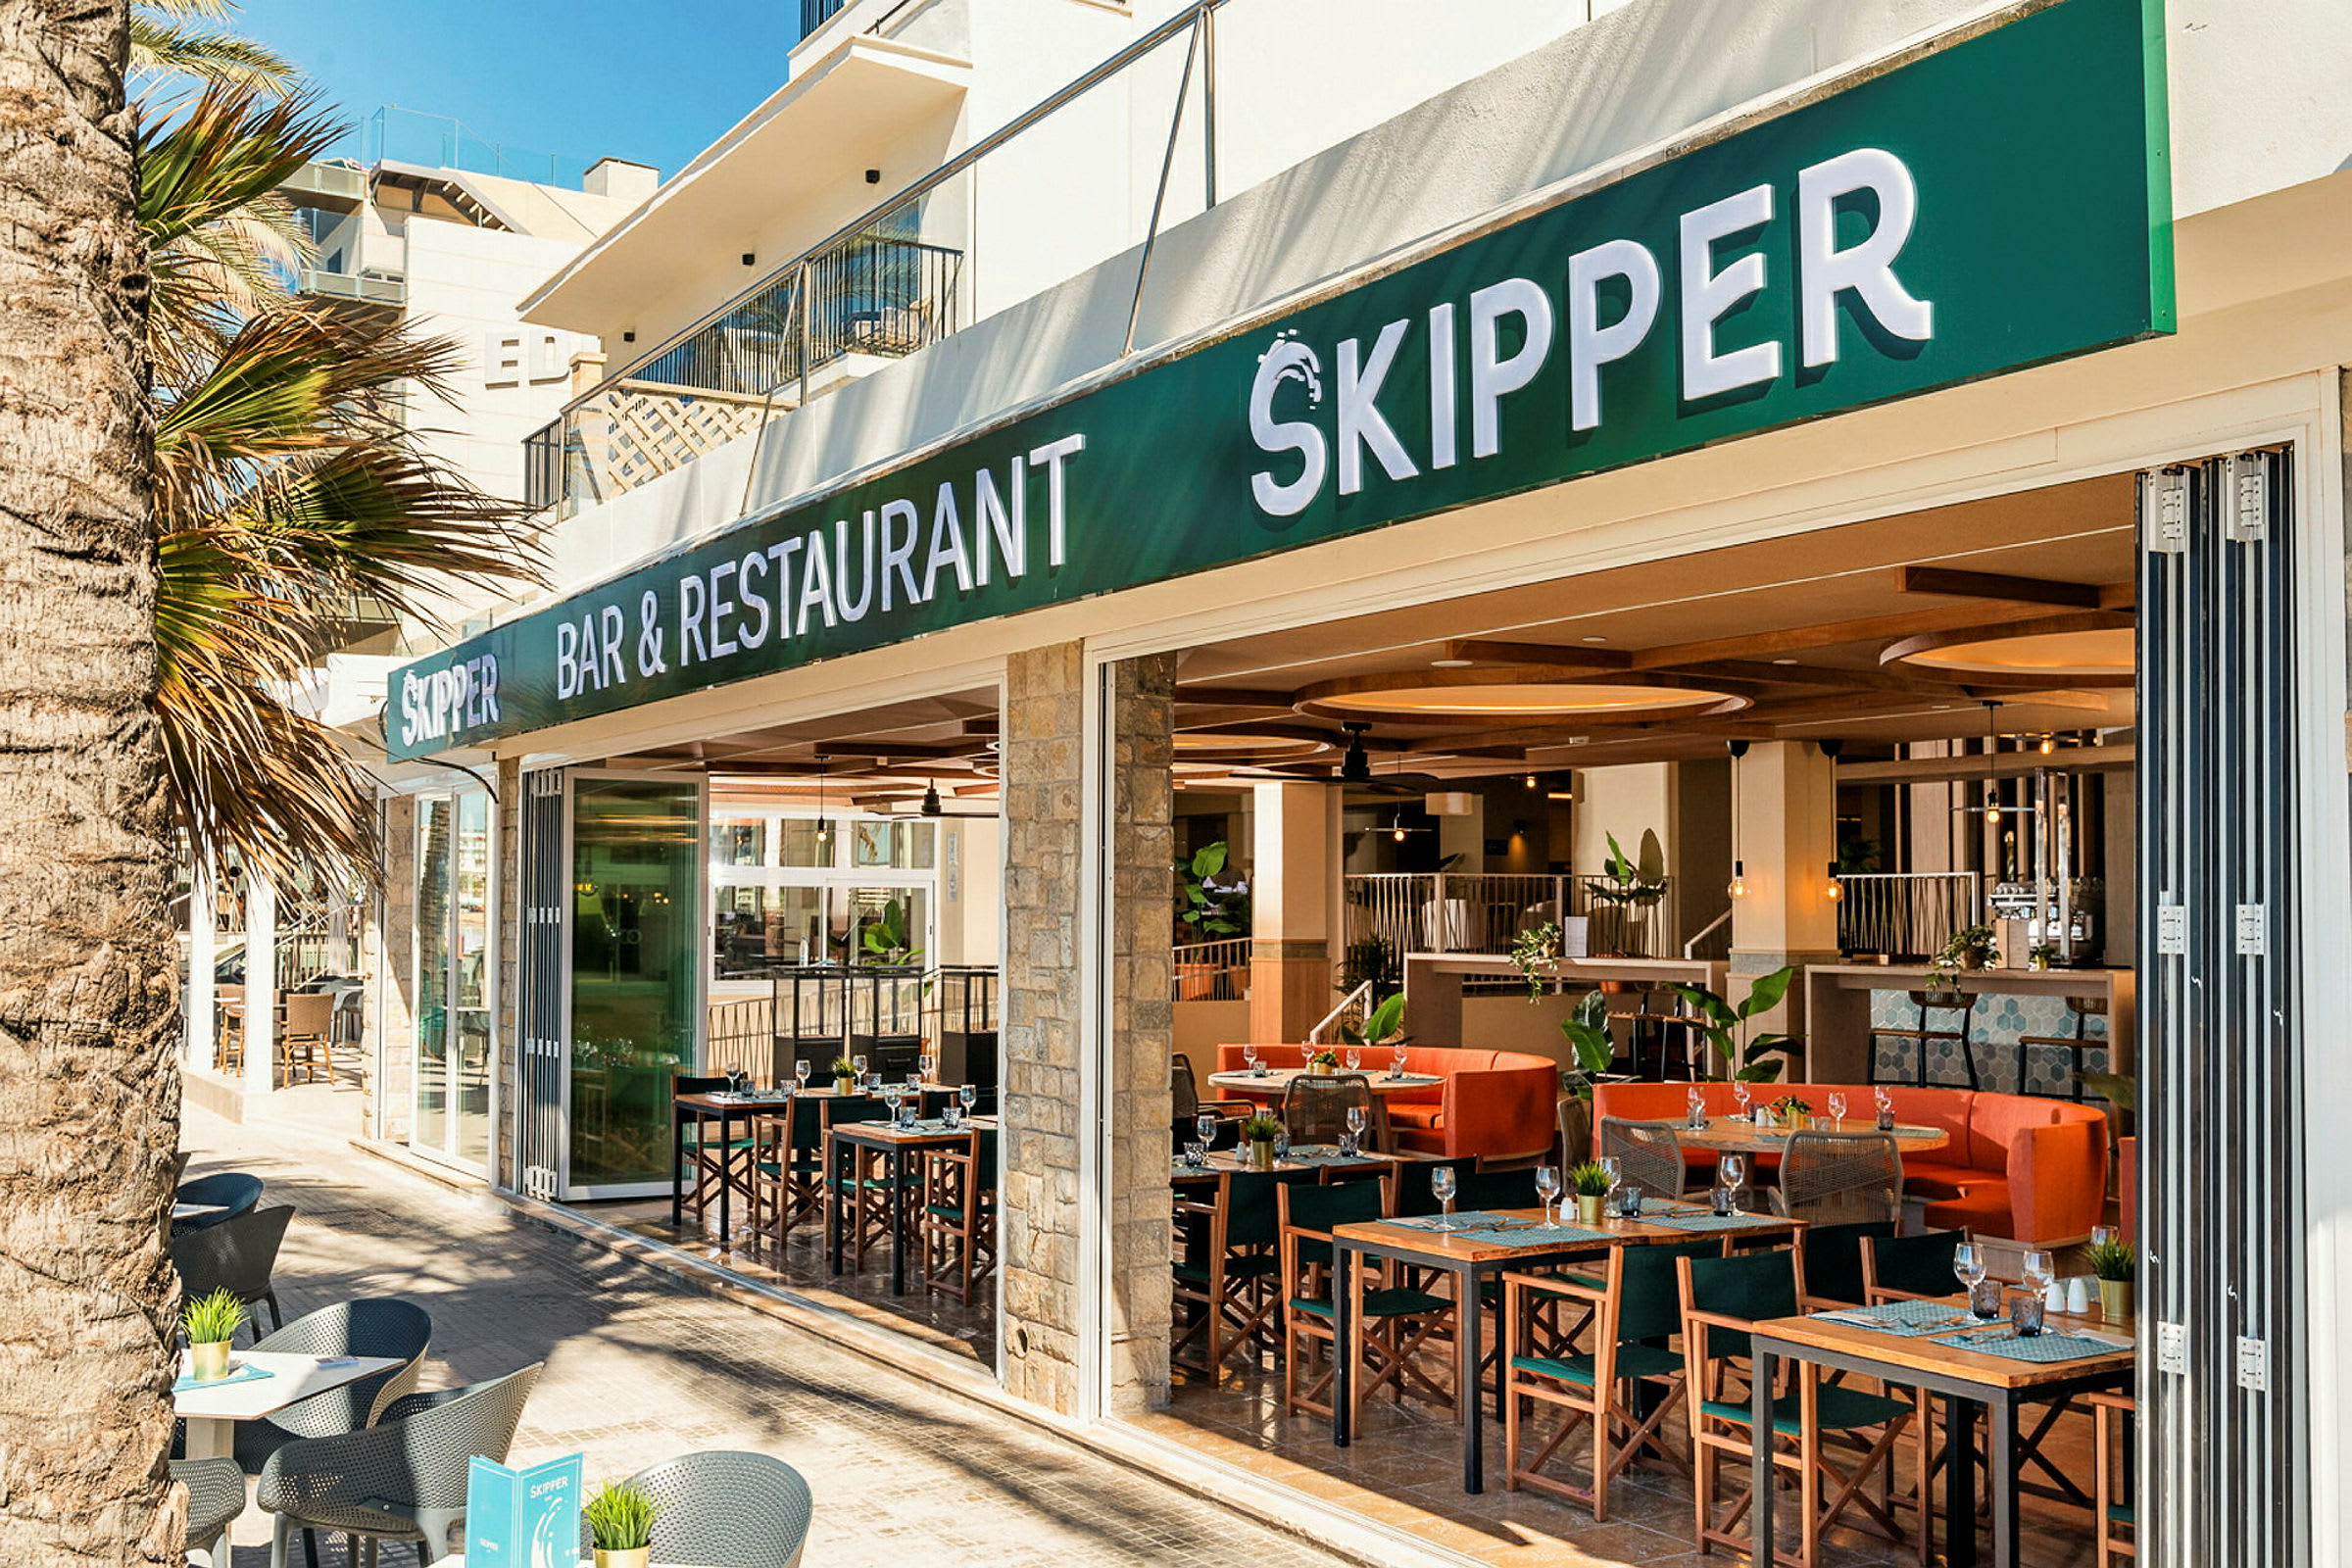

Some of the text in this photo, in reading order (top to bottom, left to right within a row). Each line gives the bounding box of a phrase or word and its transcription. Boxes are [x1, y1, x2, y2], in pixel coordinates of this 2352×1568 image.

[1249, 147, 1935, 516] SKIPPER
[557, 432, 1086, 702] BAR & RESTAURANT
[401, 653, 499, 748] SKIPPER
[529, 1476, 569, 1499] SKIPPER
